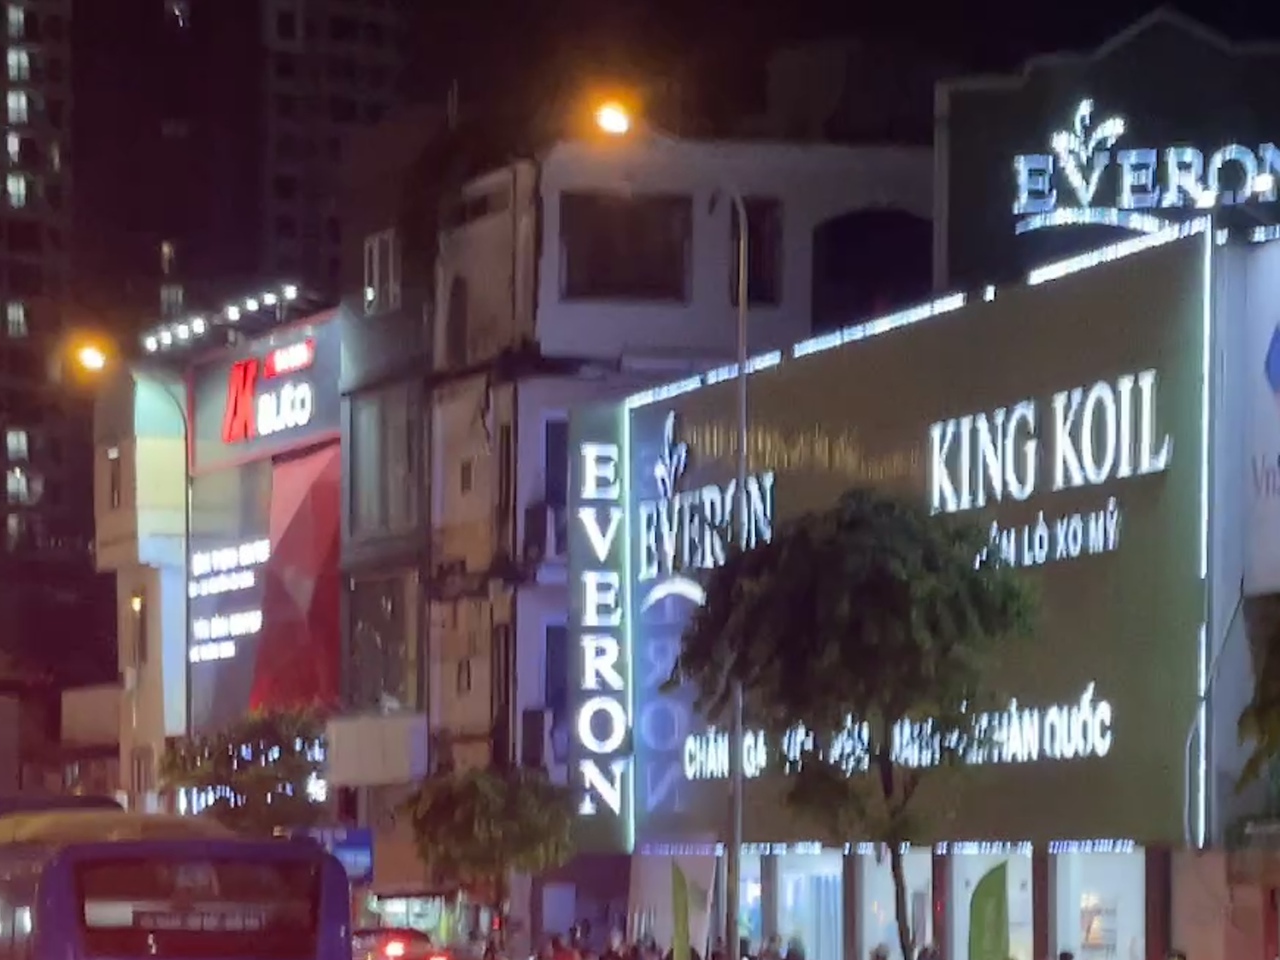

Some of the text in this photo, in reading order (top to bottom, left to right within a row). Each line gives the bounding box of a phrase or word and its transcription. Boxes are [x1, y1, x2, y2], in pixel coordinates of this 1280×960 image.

[930, 368, 1172, 516] KING KOIL
[1056, 513, 1083, 560] XO
[578, 443, 628, 816] EVERON
